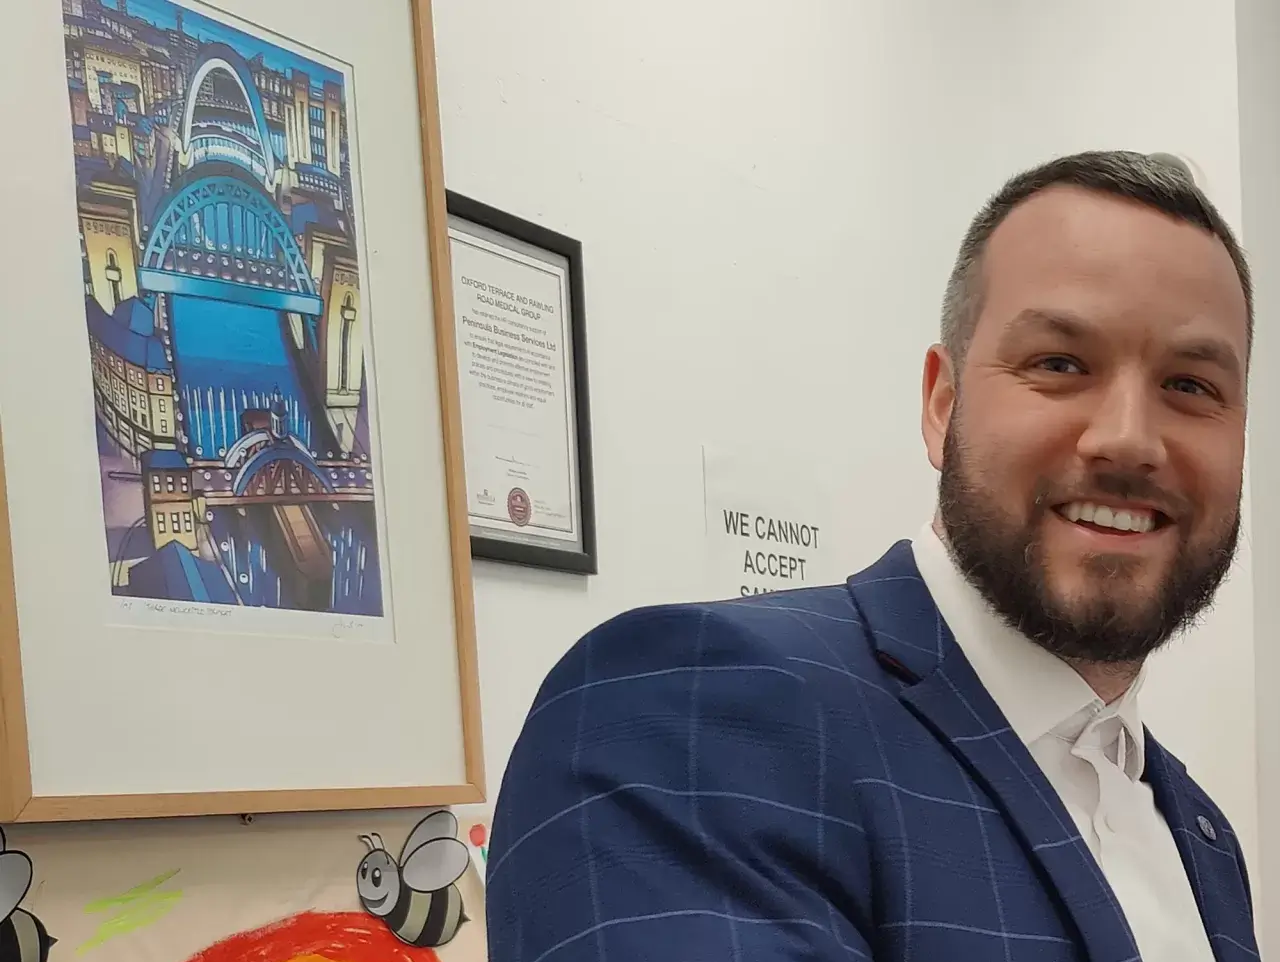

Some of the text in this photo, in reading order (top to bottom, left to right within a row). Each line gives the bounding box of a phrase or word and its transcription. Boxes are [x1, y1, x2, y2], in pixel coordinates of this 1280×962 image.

[461, 275, 554, 314] OXFORD TERRACE AND RAWLING
[477, 293, 541, 321] ROAD MEDICAL GROUP
[462, 316, 492, 332] Peninsula
[493, 324, 520, 341] Business
[521, 333, 546, 349] Services
[547, 341, 556, 352] Ltd
[723, 509, 820, 549] WE CANNOT
[744, 549, 807, 581] ACCEPT
